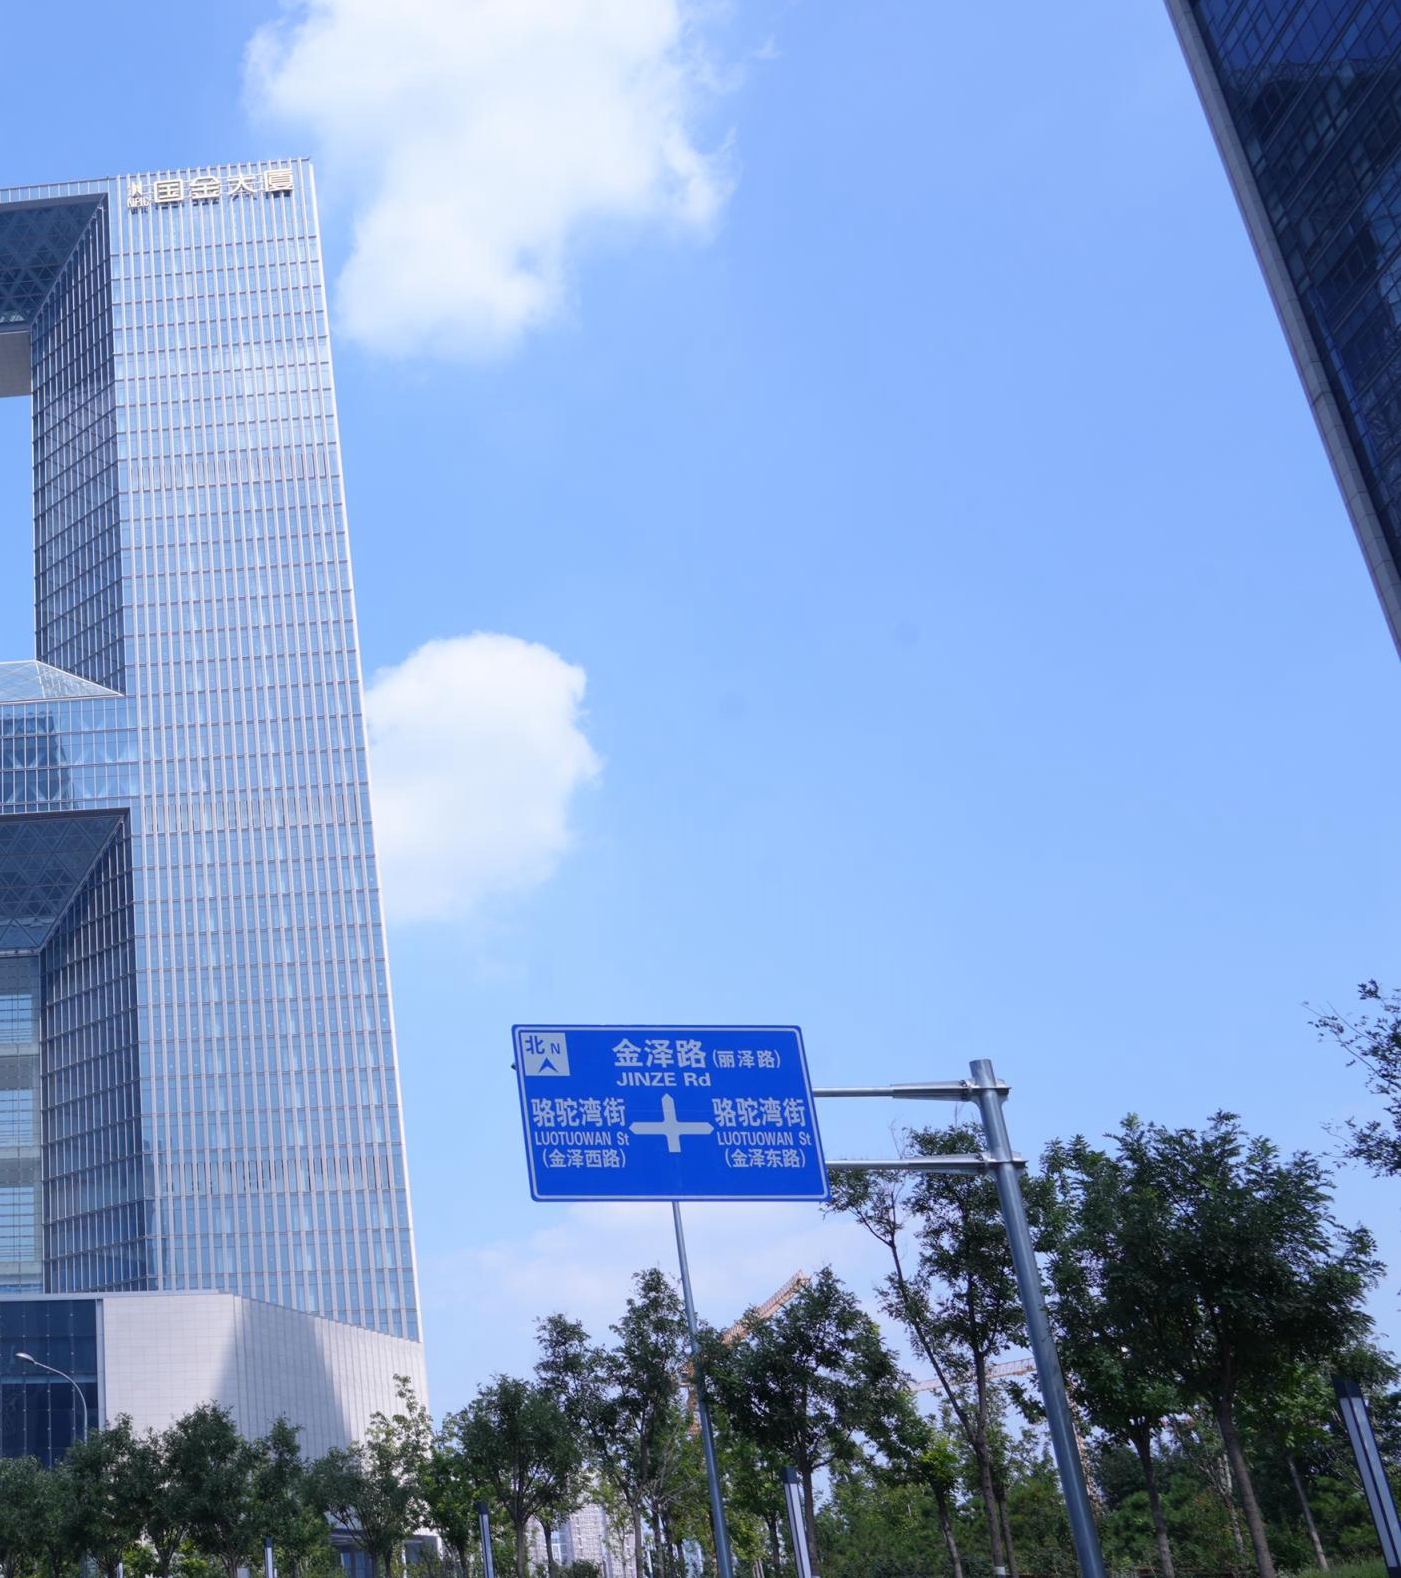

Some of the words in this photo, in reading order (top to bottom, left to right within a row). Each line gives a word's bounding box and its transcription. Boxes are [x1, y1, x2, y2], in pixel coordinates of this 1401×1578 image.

[153, 168, 295, 203] 国金大厦
[524, 1035, 546, 1054] 北
[550, 1042, 561, 1055] N
[612, 1038, 707, 1068] 金泽路
[712, 1049, 781, 1069] (丽泽路)
[616, 1072, 677, 1087] JINZE
[683, 1072, 711, 1087] Rd
[531, 1097, 626, 1127] 骆驼湾街
[711, 1097, 806, 1127] 骆驼湾街
[534, 1131, 612, 1146] LUOTUOWAN
[616, 1131, 630, 1146] St
[716, 1131, 794, 1146] LUOTUOWAN
[798, 1131, 812, 1146] St
[542, 1148, 626, 1169] (金泽西路)
[725, 1148, 806, 1169] (金泽东路)
